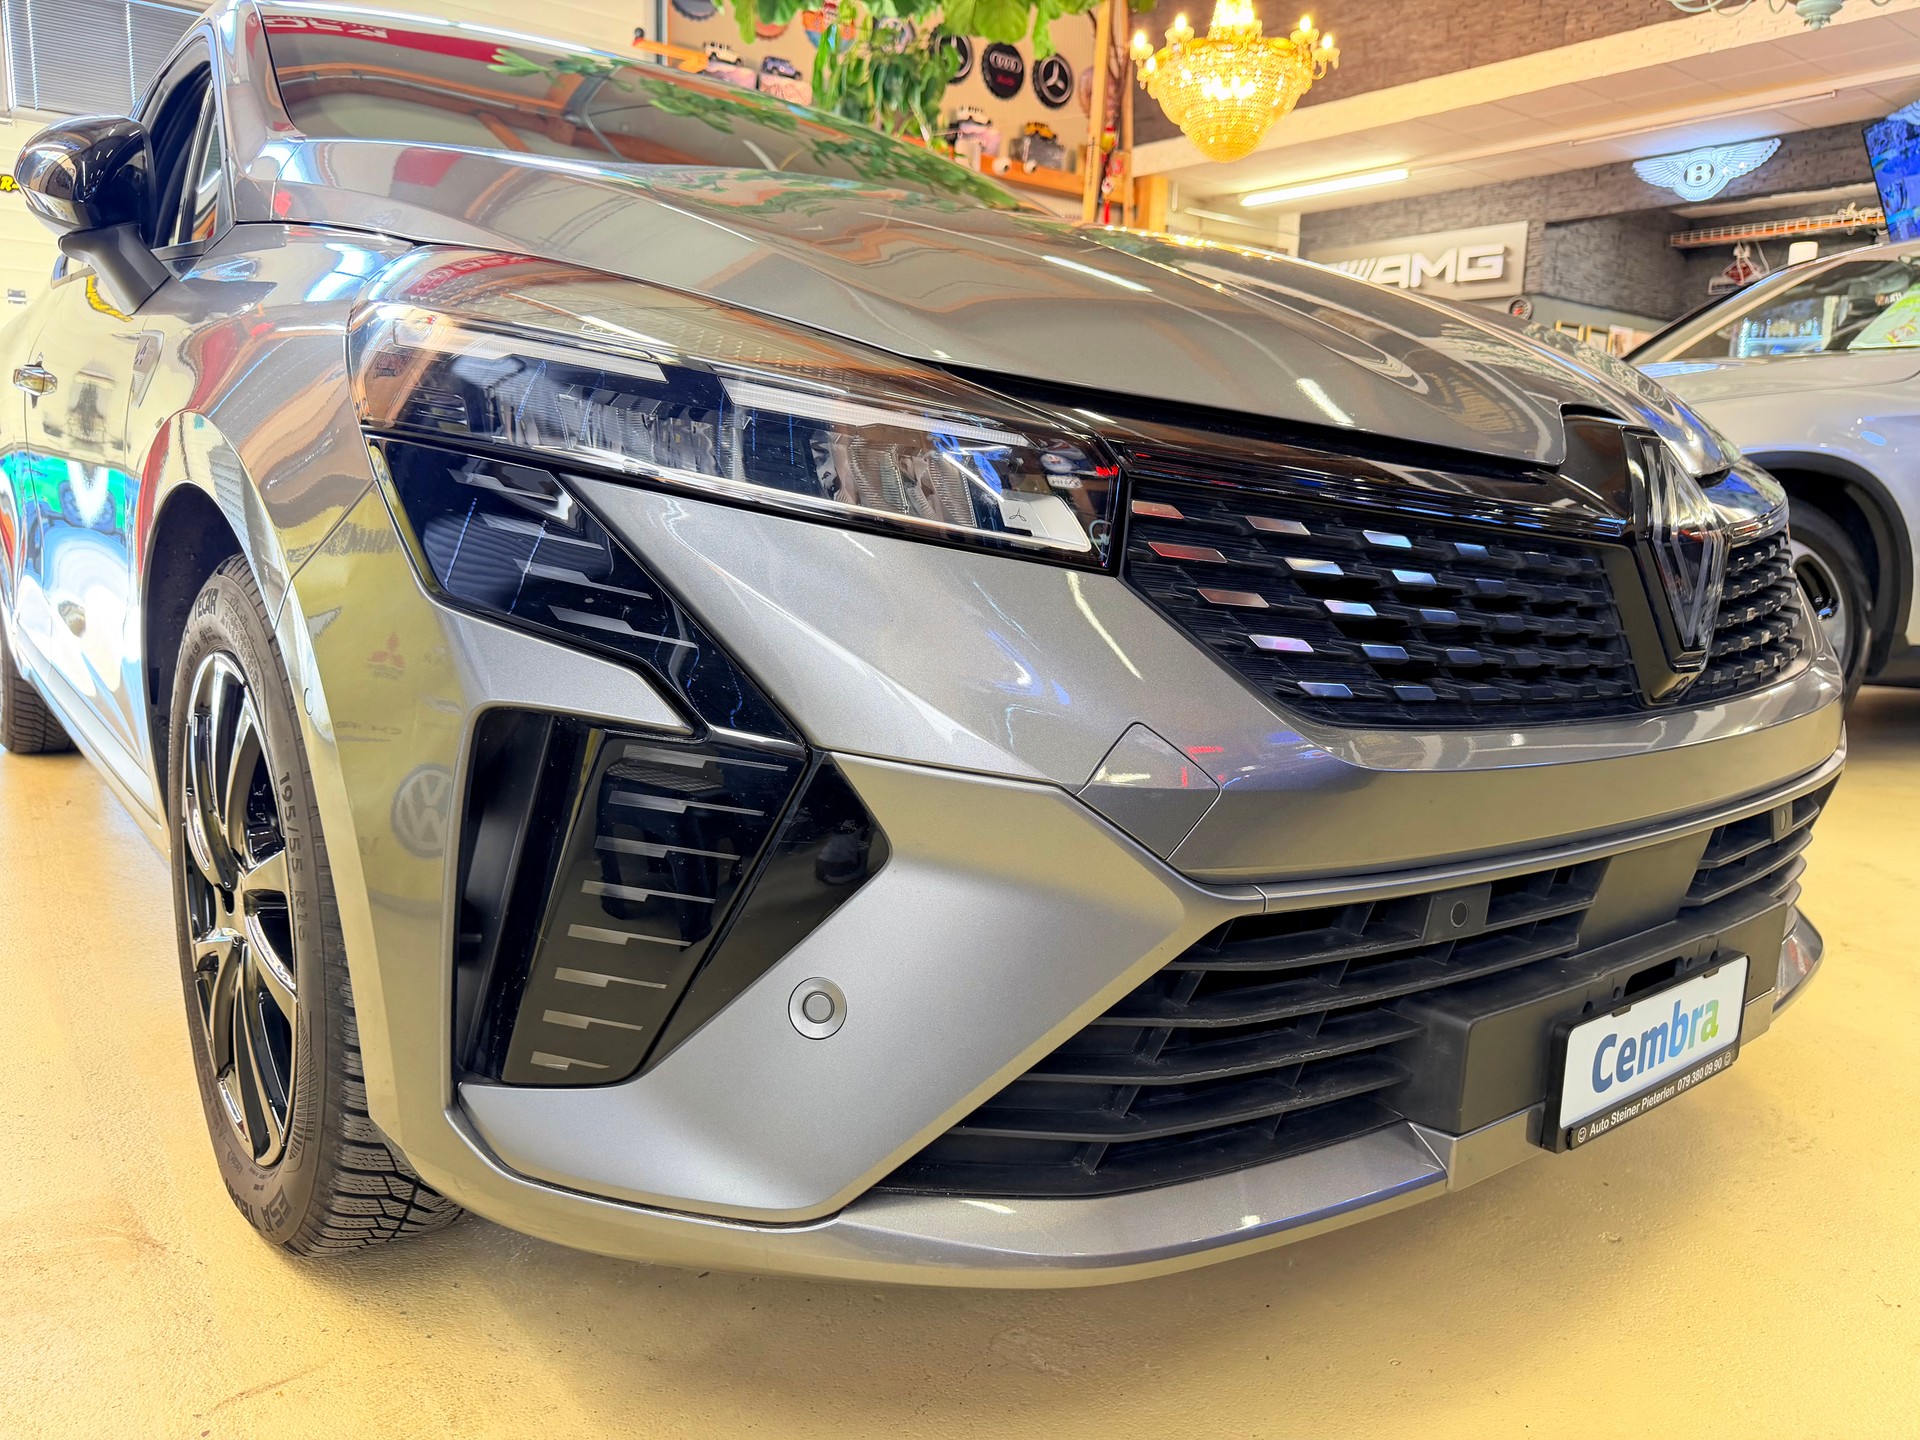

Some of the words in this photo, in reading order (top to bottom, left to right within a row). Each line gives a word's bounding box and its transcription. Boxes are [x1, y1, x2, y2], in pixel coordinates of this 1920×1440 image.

[1368, 244, 1505, 288] AMG
[278, 771, 304, 874] 195/55
[1591, 999, 1719, 1093] Cembra
[1589, 1117, 1609, 1137] Auto
[1611, 1102, 1641, 1126] Steiner
[1641, 1085, 1675, 1111] Pieterlen
[1677, 1075, 1690, 1092] 079
[1691, 1068, 1703, 1084] 380
[1704, 1063, 1713, 1077] 09
[1713, 1058, 1723, 1073] 90
